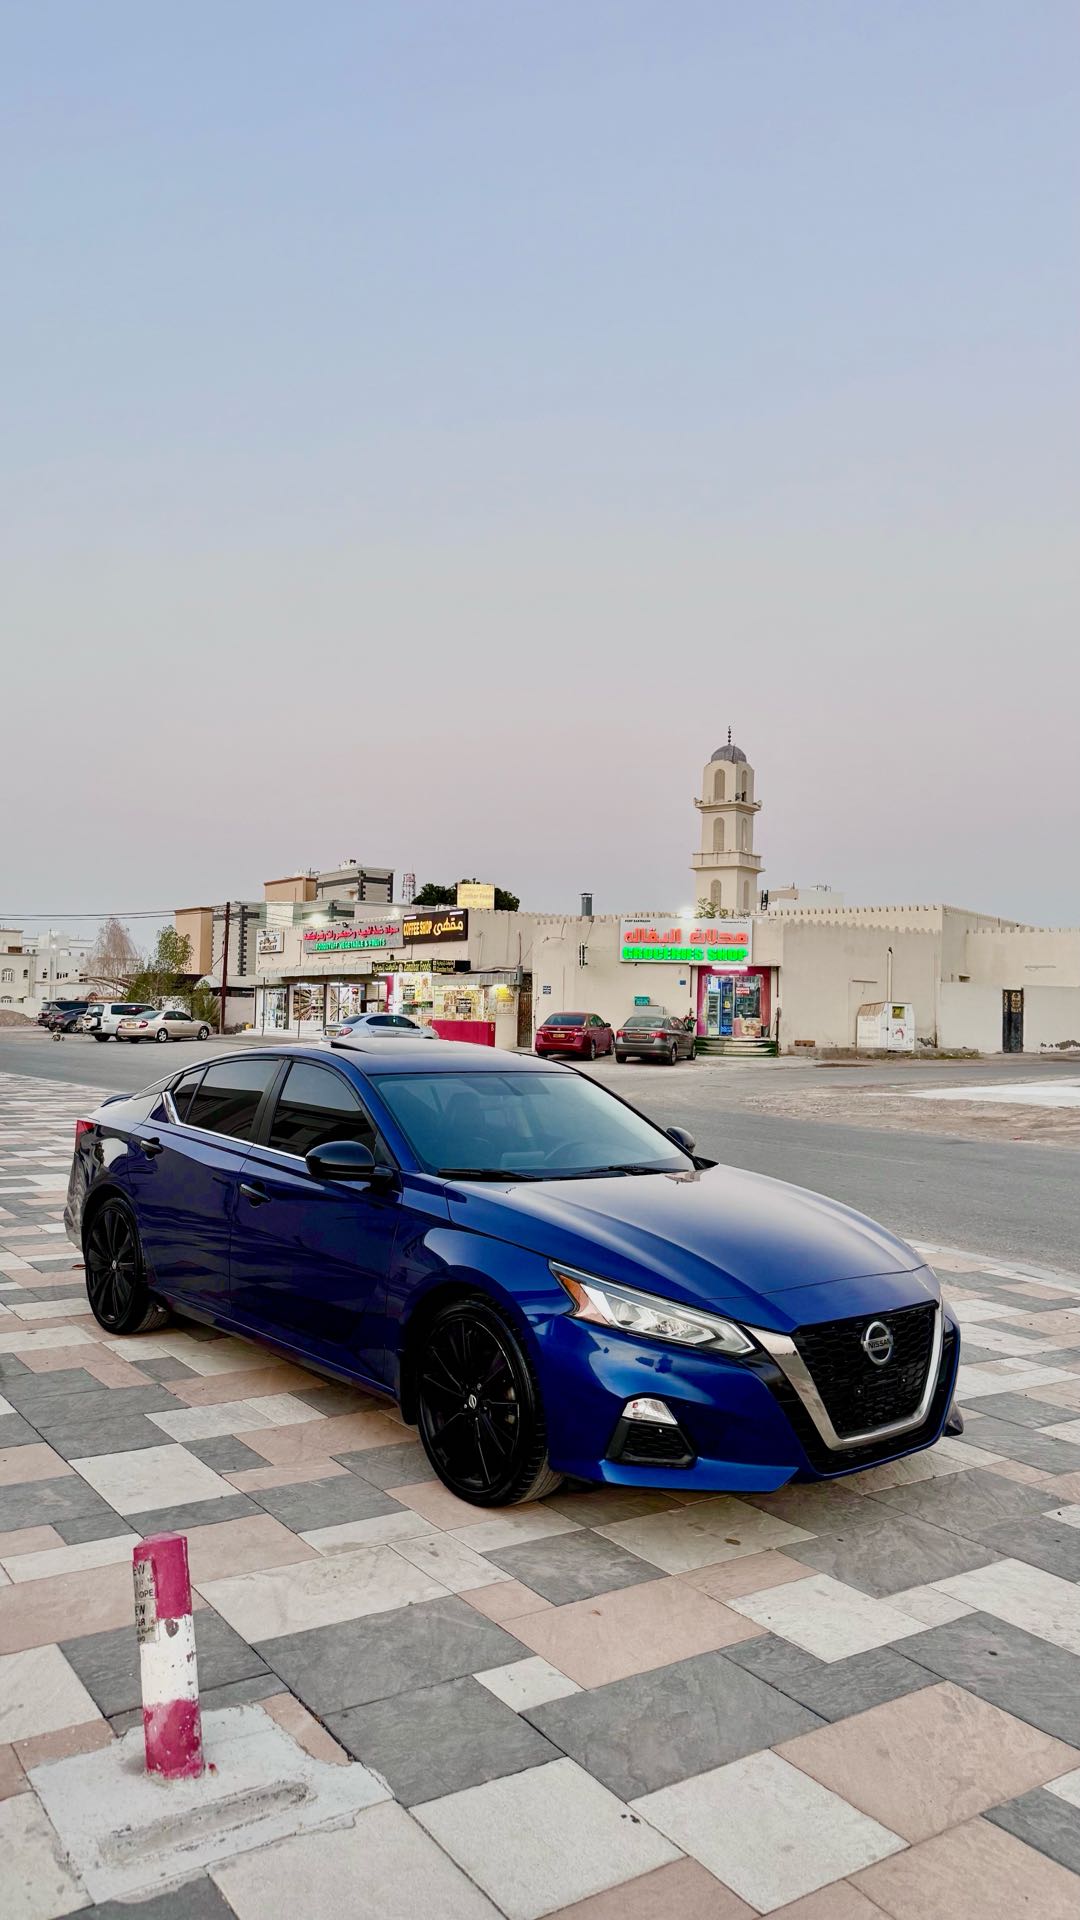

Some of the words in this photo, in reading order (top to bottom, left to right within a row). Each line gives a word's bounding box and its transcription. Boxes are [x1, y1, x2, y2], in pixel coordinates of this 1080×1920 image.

[404, 921, 420, 936] COFFEE
[420, 920, 433, 935] SHOP
[433, 917, 464, 936] مقهى
[689, 928, 748, 945] محلات
[622, 947, 705, 961] GROCERIES
[707, 947, 749, 961] SHOP
